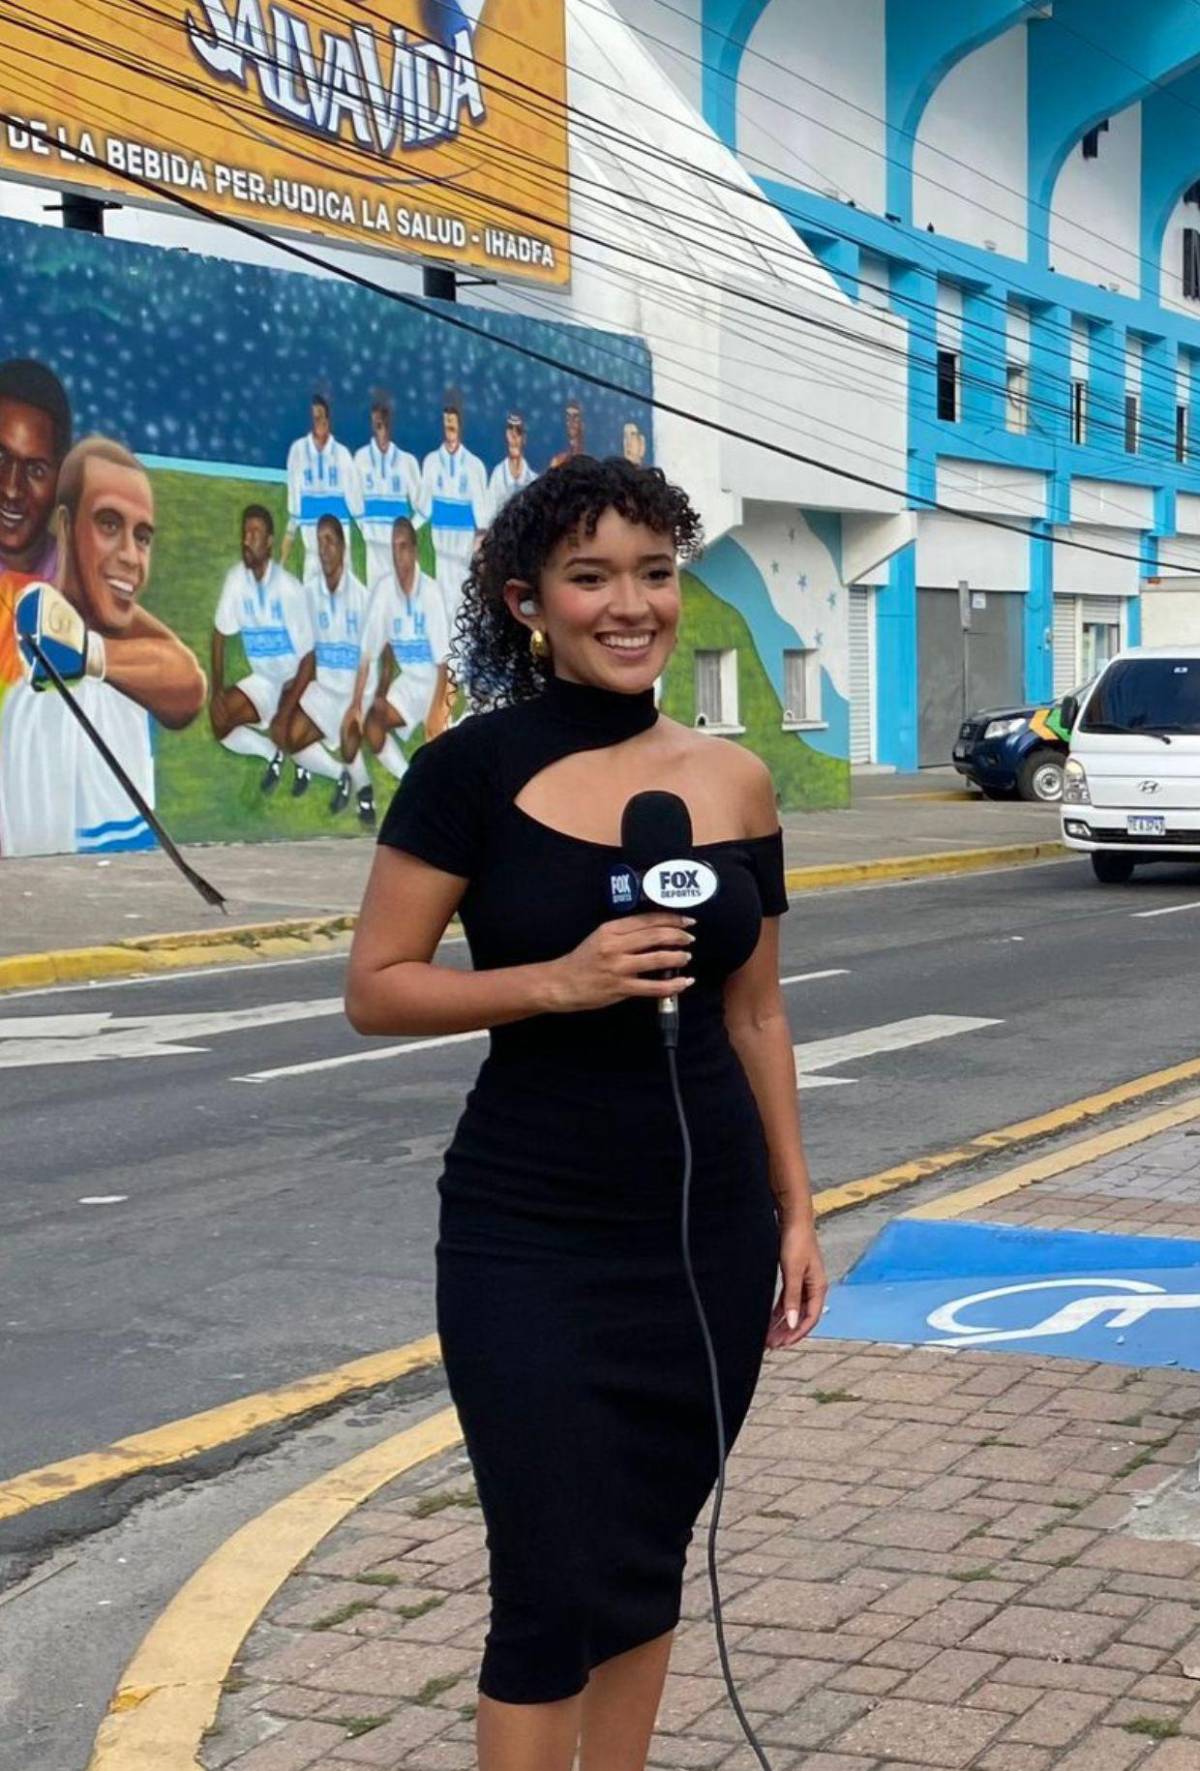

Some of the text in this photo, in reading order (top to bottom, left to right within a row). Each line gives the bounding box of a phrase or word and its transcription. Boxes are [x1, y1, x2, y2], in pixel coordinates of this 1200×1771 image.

[8, 115, 49, 155] DE
[58, 127, 96, 164] LA
[106, 138, 208, 191] BEBIDA
[214, 164, 356, 225] PERJUDICA
[362, 199, 391, 232] LA
[397, 207, 466, 248] SALUD
[485, 227, 555, 268] IHADFA
[610, 874, 631, 894] FOX
[659, 870, 699, 890] FOX
[660, 890, 702, 899] DEPORTES
